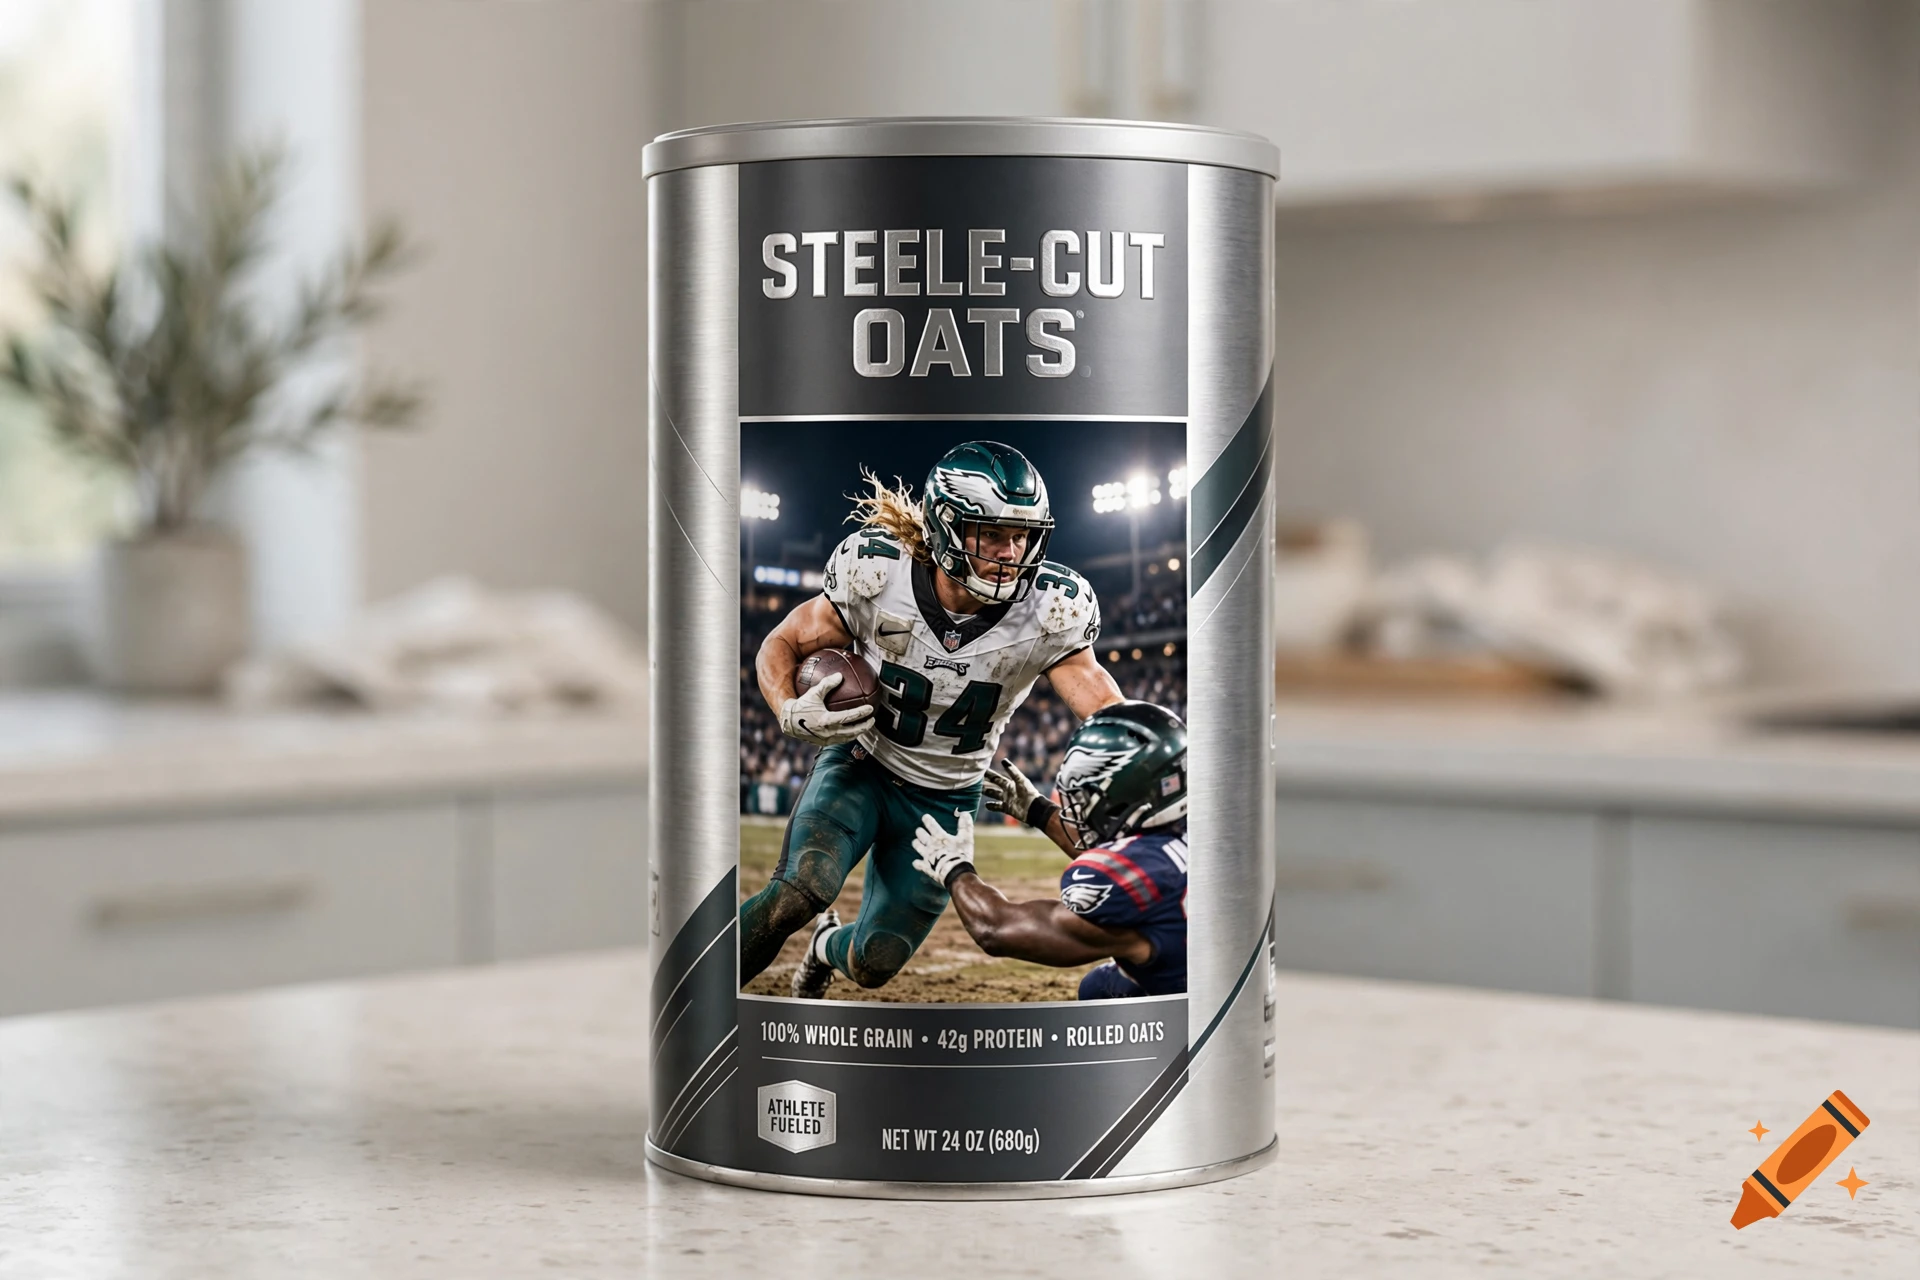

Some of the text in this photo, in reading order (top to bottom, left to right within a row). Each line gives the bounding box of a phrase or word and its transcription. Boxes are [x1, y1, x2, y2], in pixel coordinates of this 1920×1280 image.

[762, 229, 1166, 299] STEELE-CUT
[852, 307, 1076, 378] OATS
[874, 660, 1003, 755] 34
[761, 1021, 1165, 1053] 100% WHOLE GRAIN 42g PROTEIN ROLLED OATS
[767, 1098, 826, 1118] ATHLETE
[770, 1118, 821, 1136] FUELED
[882, 1127, 1040, 1155] NET WT 24 OZ (680g)
